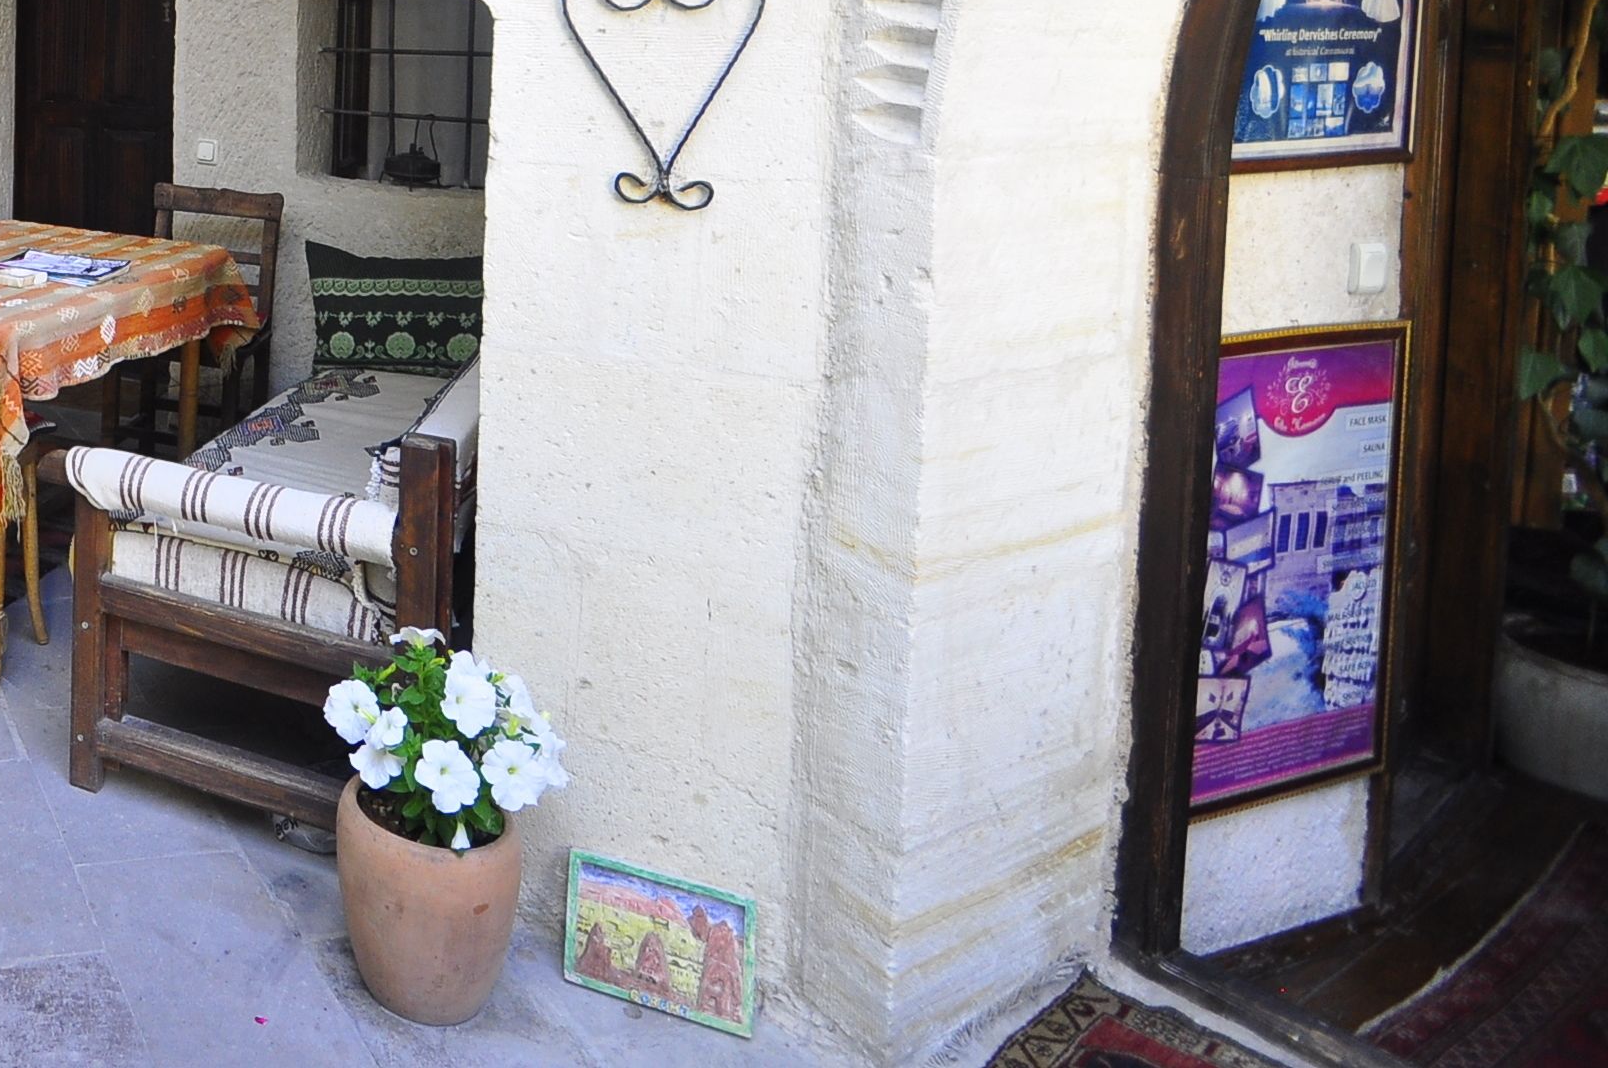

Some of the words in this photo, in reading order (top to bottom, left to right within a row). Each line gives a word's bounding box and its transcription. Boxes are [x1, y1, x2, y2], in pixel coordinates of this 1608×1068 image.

[1298, 28, 1338, 41] Dervishes
[1349, 415, 1366, 427] FACE
[1367, 413, 1387, 425] MASK
[1363, 442, 1385, 453] SAUNA
[1342, 472, 1356, 483] and
[1356, 469, 1384, 481] PEELING
